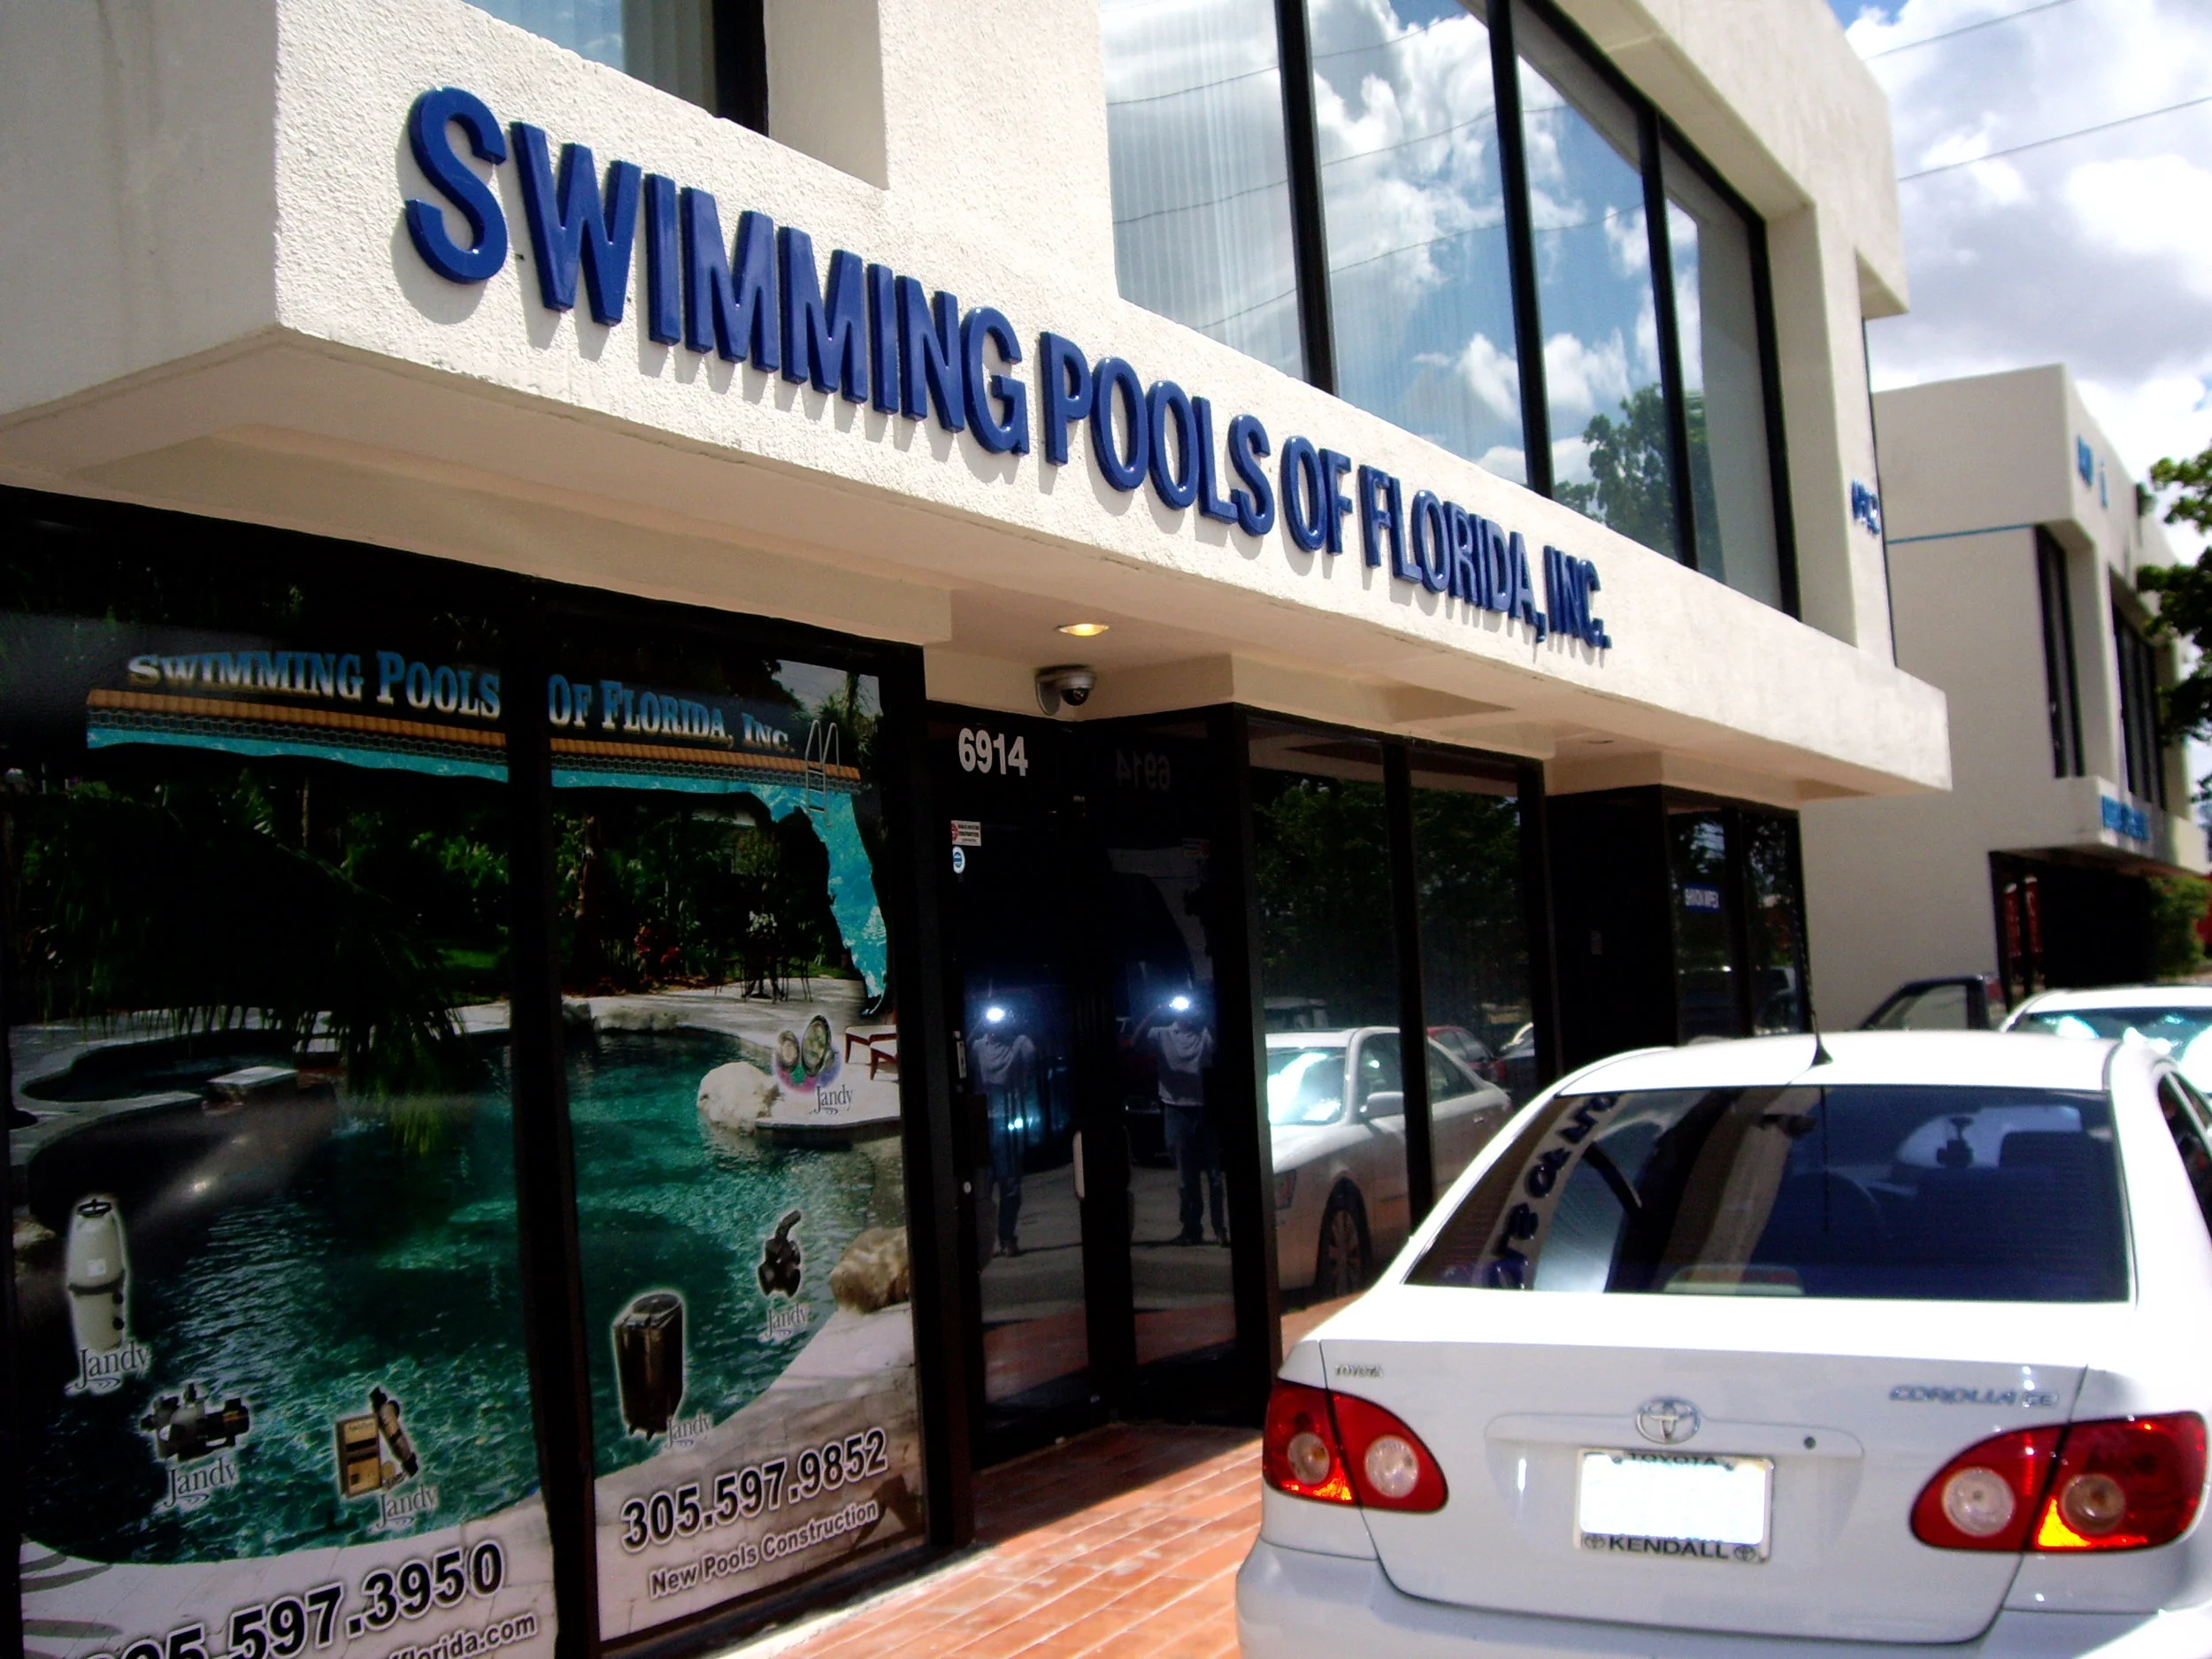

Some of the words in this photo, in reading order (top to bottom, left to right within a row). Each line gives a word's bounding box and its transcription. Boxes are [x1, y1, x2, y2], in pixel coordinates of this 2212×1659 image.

[404, 87, 1030, 457] SWIMMING
[1039, 331, 1275, 537] POOLS
[1280, 435, 1353, 556] OF
[1358, 464, 1547, 643] FLORIDA,
[1543, 545, 1613, 649] INC.
[128, 650, 365, 703] SWIMMING
[376, 649, 502, 721] POOLS
[548, 673, 592, 729] OF
[958, 727, 1028, 777] 6914
[813, 1083, 854, 1115] Jandy
[75, 1340, 148, 1390] Jandy
[164, 1457, 237, 1508] Jandy
[1629, 1453, 1719, 1467] TOYOTA
[376, 1483, 439, 1529] Jandy
[621, 1427, 887, 1552] 305.597.9852
[650, 1564, 699, 1598] New
[703, 1545, 757, 1579] Pools
[762, 1501, 878, 1560] Construction
[1609, 1535, 1730, 1560] KENDALL
